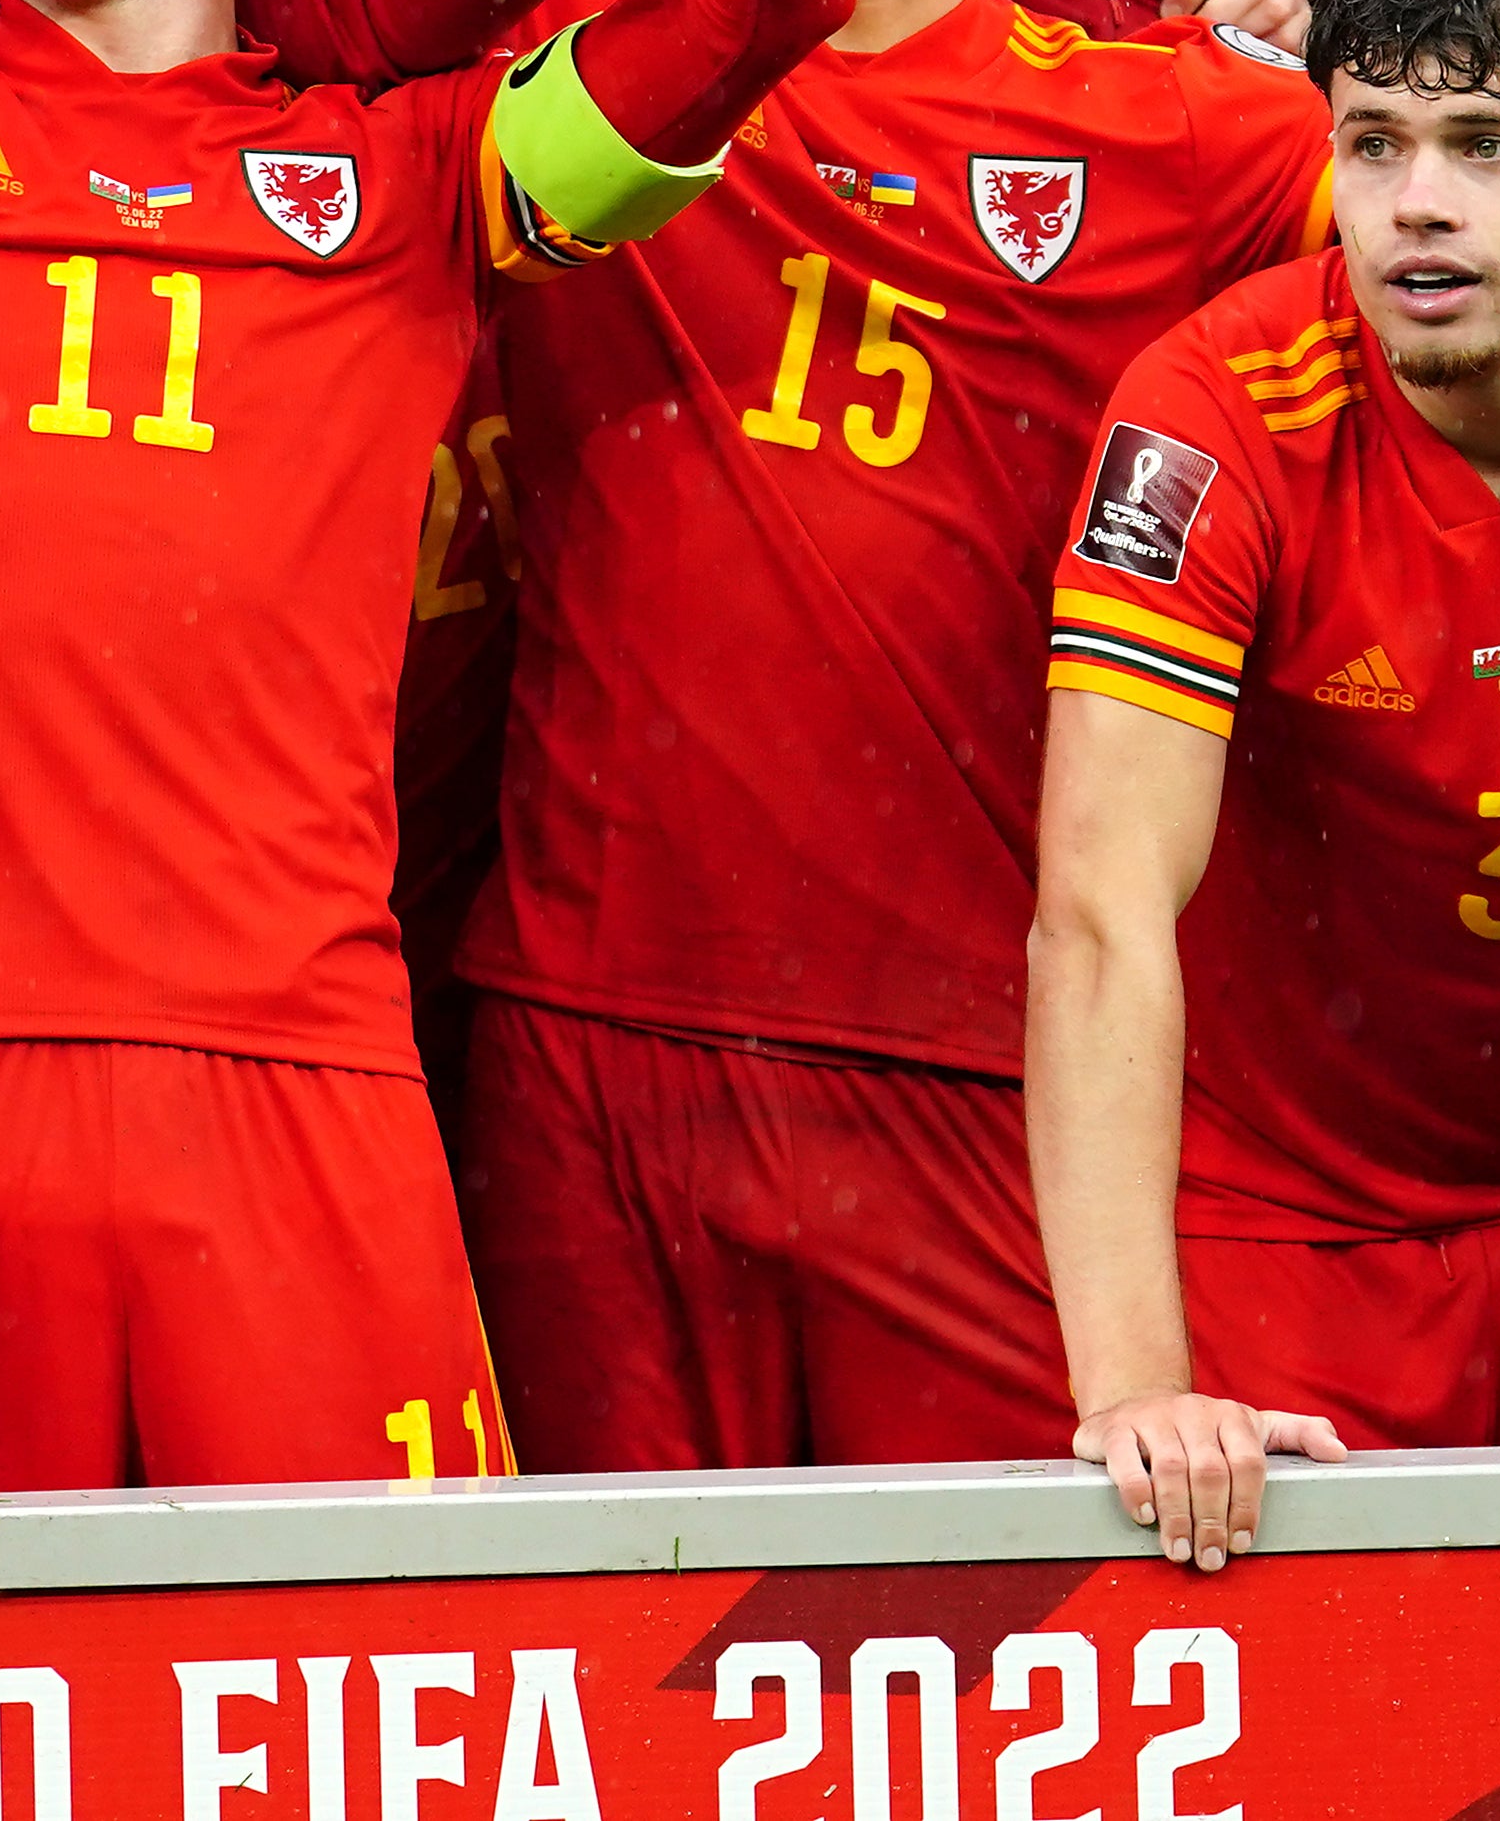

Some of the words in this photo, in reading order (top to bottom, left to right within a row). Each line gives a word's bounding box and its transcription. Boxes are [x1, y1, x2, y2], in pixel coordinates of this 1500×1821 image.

[115, 203, 164, 220] 05.06.22
[131, 191, 146, 204] VS
[28, 255, 216, 454] 11
[741, 252, 948, 469] 15
[1093, 526, 1159, 559] Qualifiers
[1314, 684, 1416, 712] adidas
[170, 1647, 603, 1821] FIFA
[712, 1626, 1243, 1821] 2022
